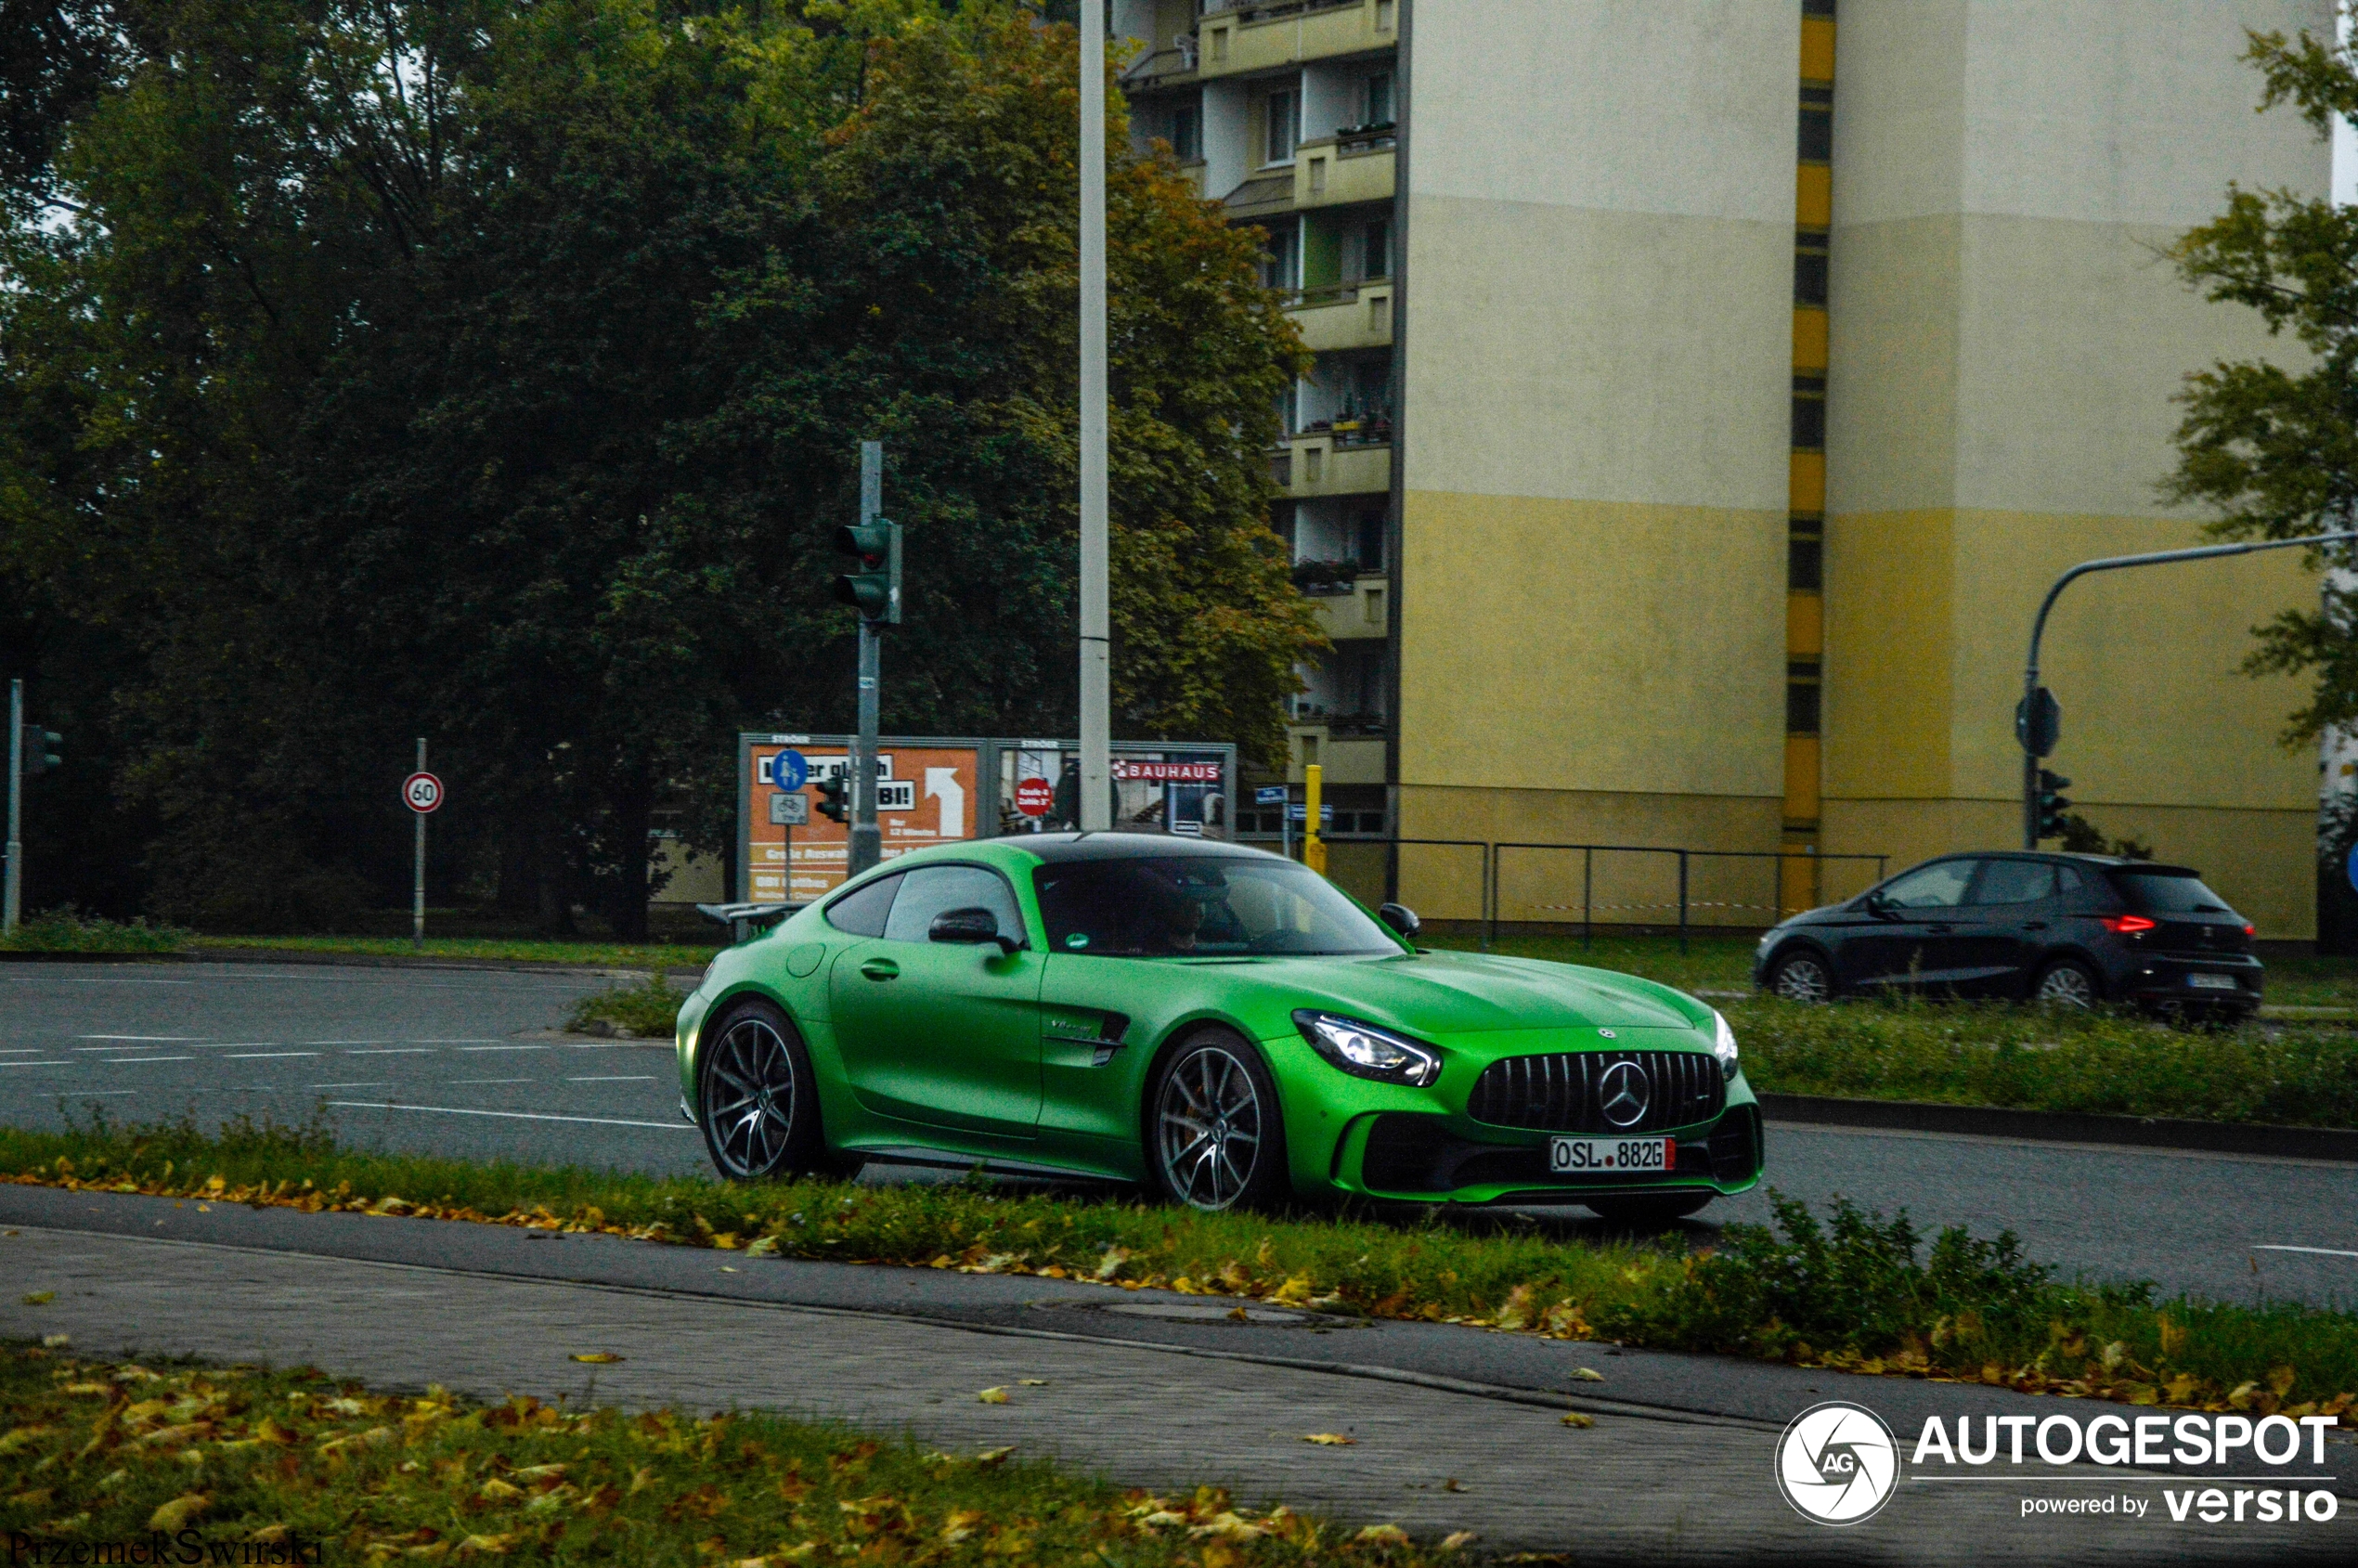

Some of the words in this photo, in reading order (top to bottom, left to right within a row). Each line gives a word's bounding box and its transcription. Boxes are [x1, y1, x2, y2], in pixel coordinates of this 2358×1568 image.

[1129, 765, 1218, 778] BAUHAUS
[412, 784, 434, 801] 60
[1555, 1141, 1602, 1168] OSL
[1617, 1141, 1663, 1168] 882G
